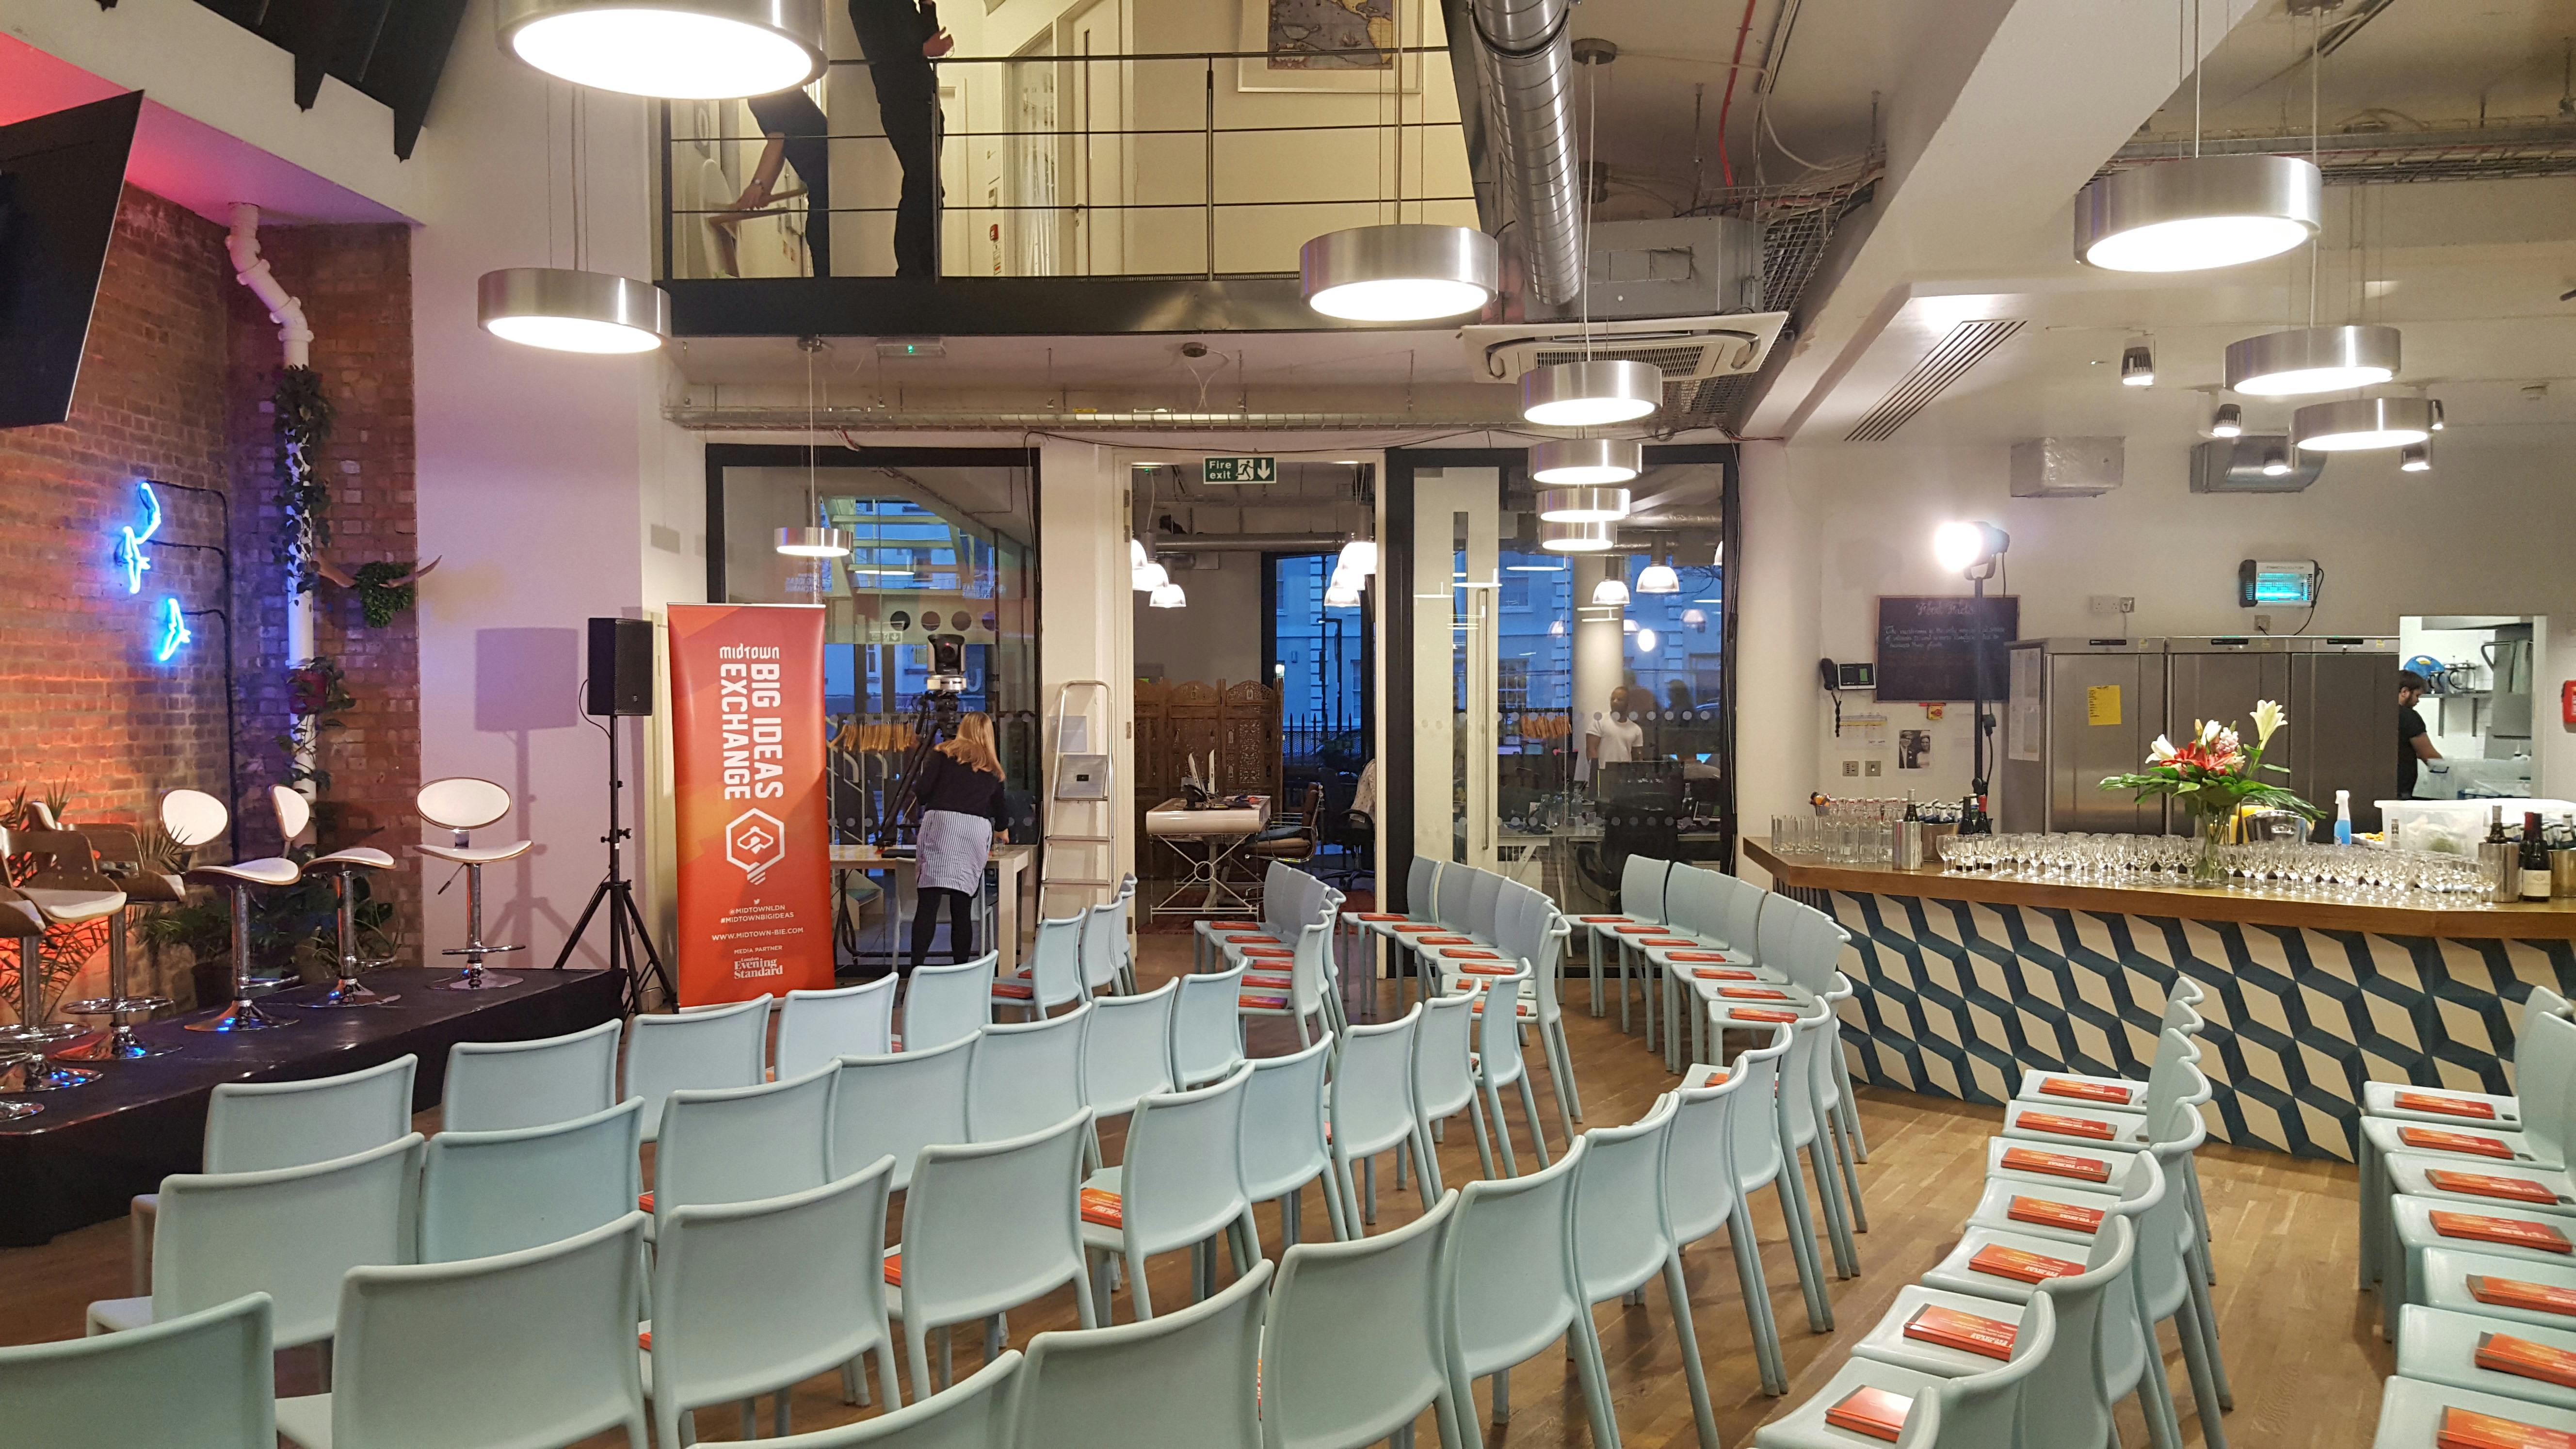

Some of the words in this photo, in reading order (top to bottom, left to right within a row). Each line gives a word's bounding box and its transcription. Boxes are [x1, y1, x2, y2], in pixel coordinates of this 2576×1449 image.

[1209, 460, 1232, 469] Fire
[1209, 470, 1231, 479] exit
[751, 663, 781, 708] BIG
[720, 663, 751, 800] EXCHANGE
[753, 717, 784, 798] IDEAS
[729, 904, 785, 916] @MIDTOWNLDN
[721, 912, 794, 924] #MIDTOWNBIGIDEAS
[711, 927, 804, 941] WWW.MIDTOWN-BIE.COM
[734, 958, 777, 970] Evening
[734, 965, 784, 979] Standard
